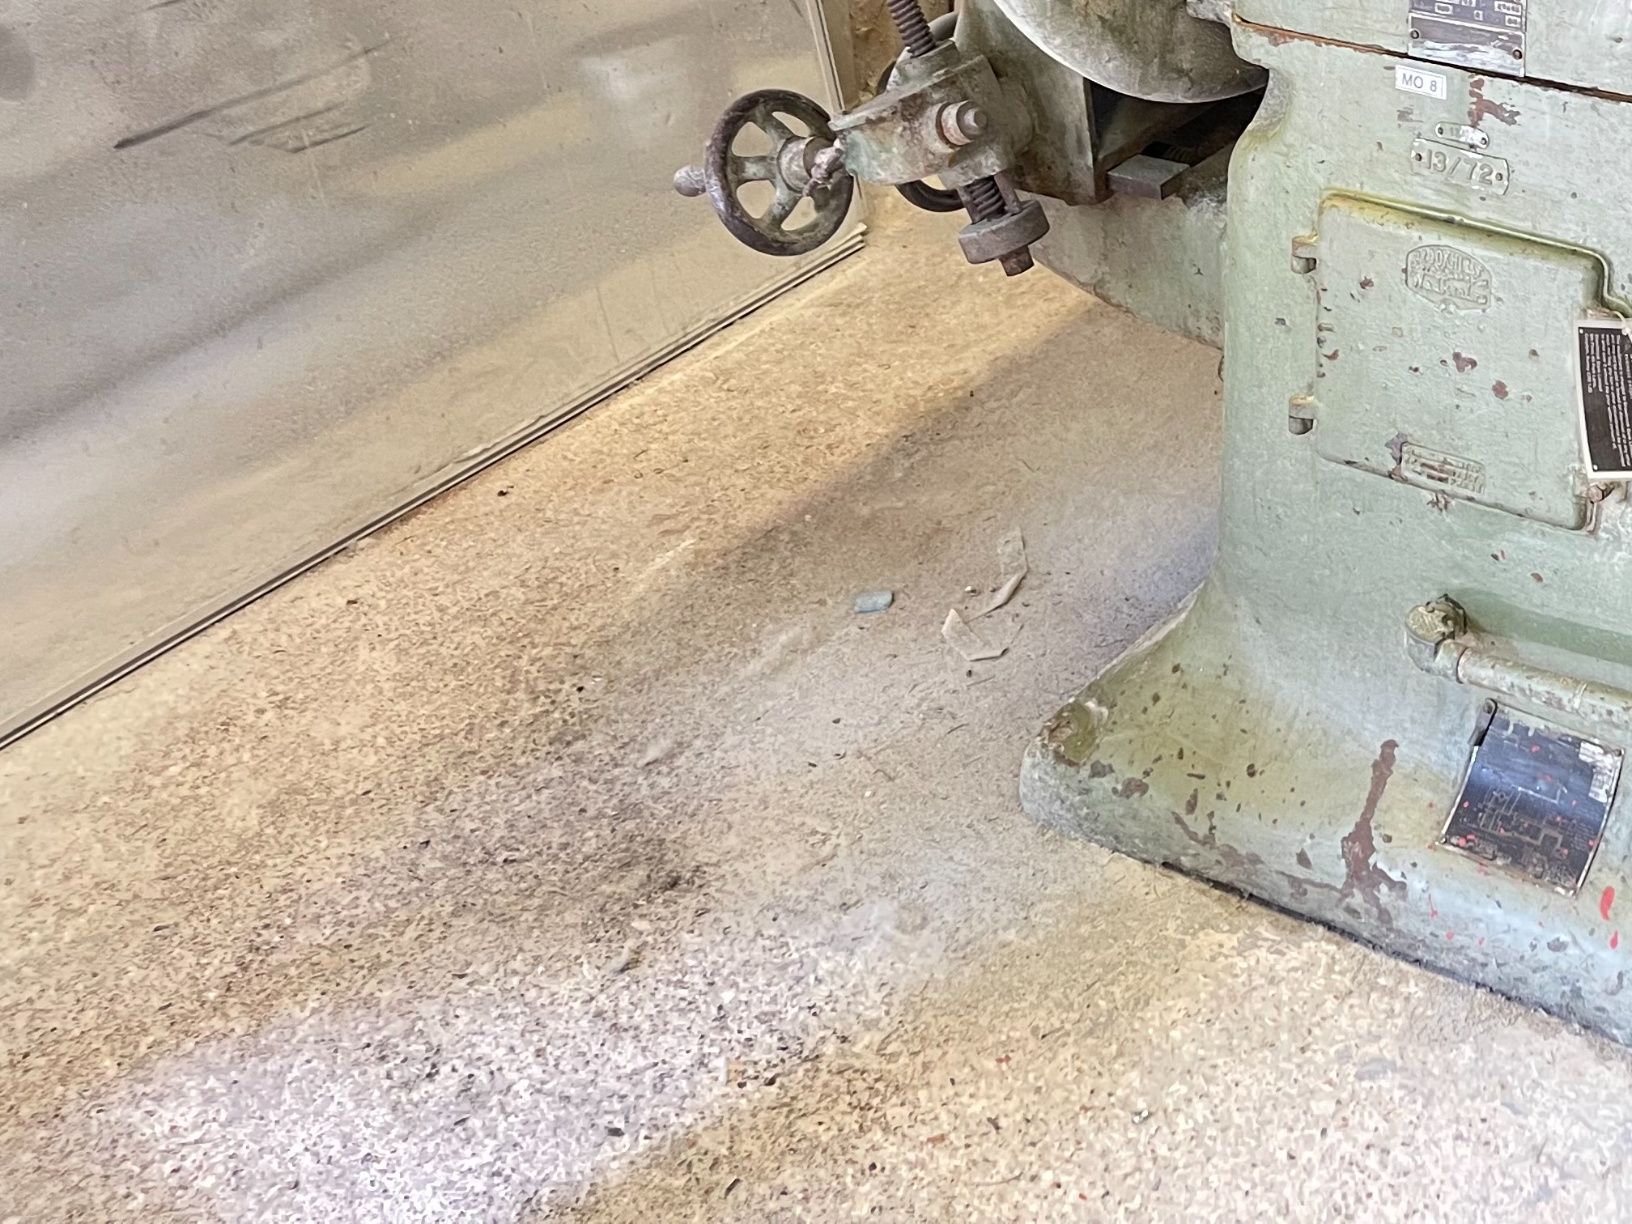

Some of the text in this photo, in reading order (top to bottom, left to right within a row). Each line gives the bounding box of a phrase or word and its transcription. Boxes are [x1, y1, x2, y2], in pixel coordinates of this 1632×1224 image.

[1401, 73, 1438, 92] MO 8
[1427, 149, 1493, 186] 13/72
